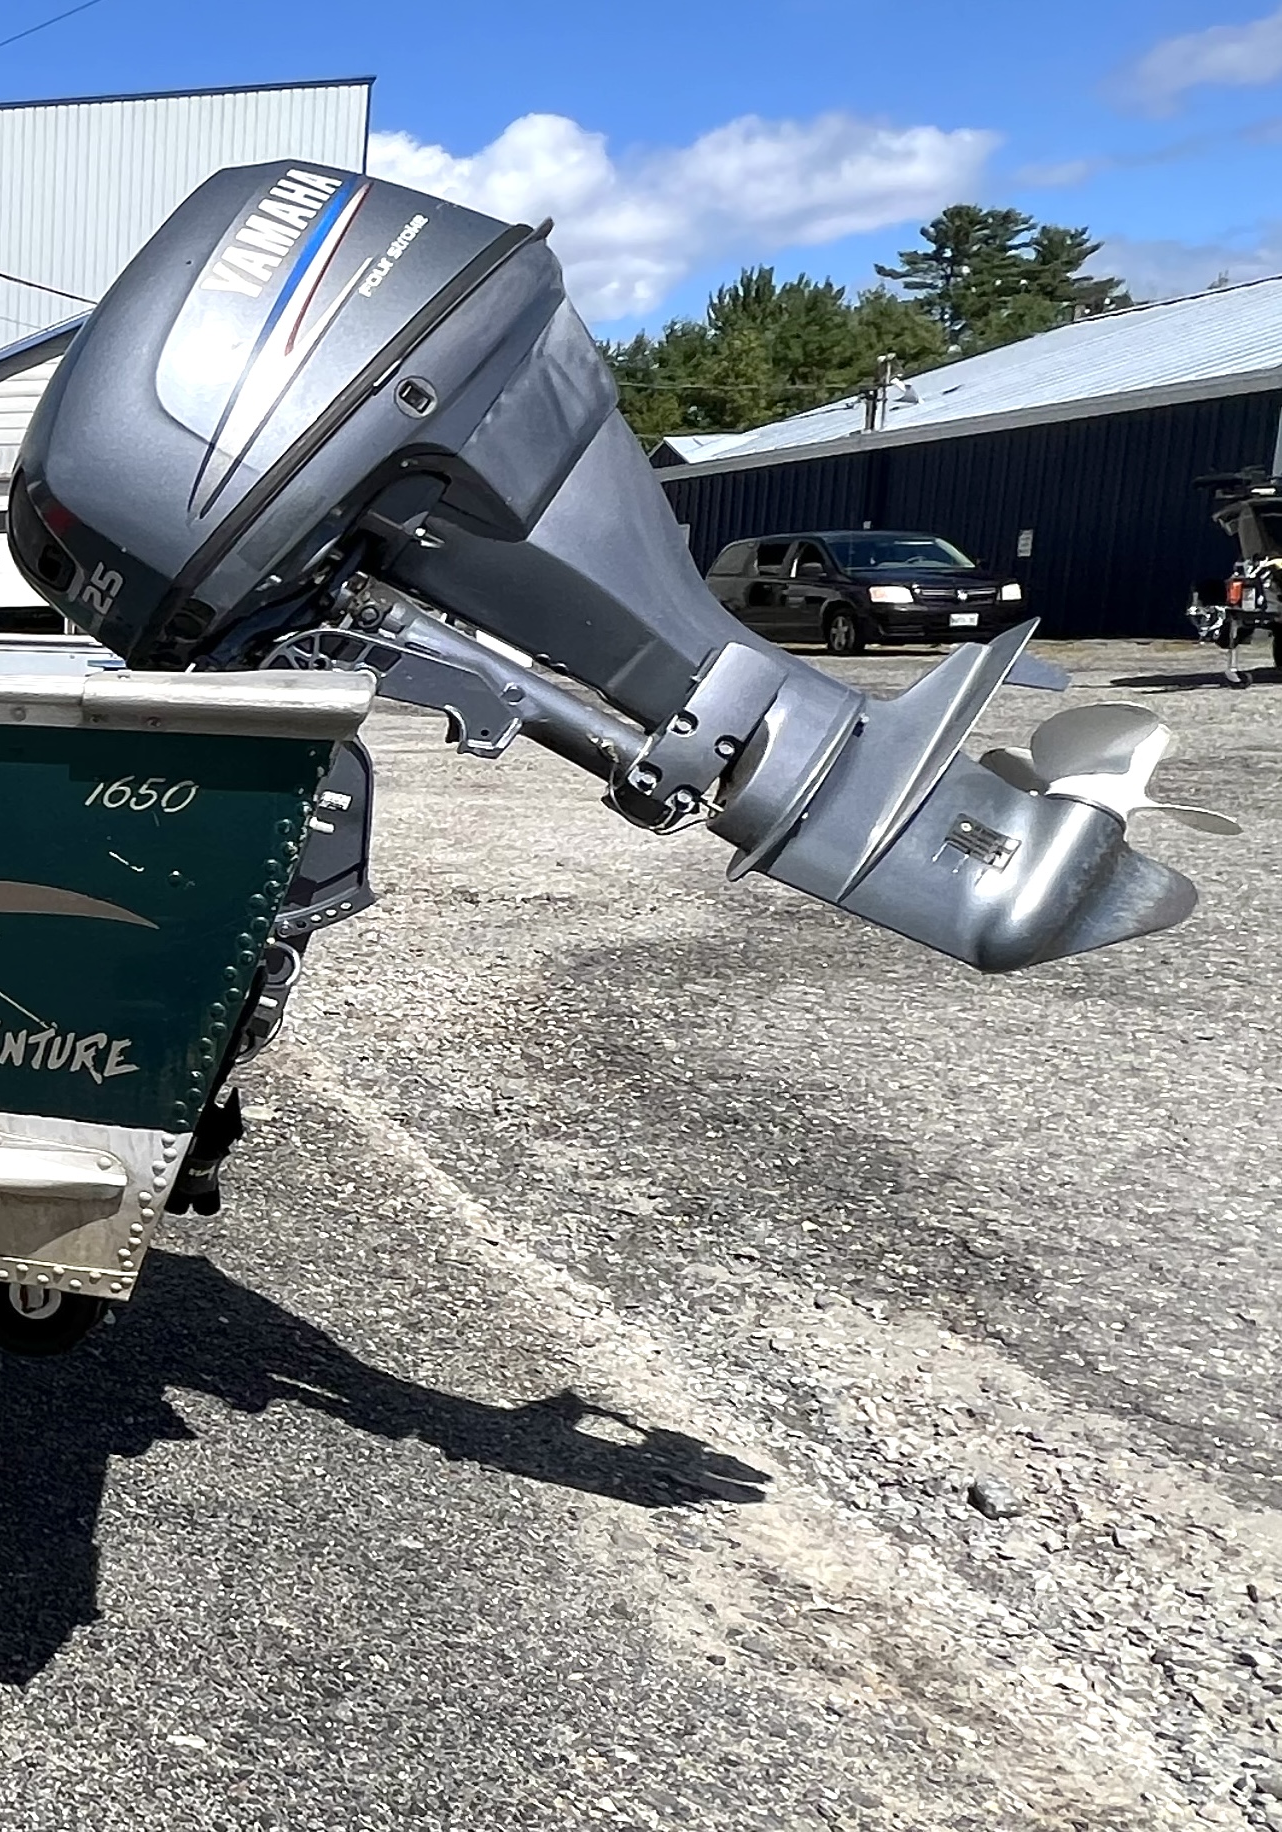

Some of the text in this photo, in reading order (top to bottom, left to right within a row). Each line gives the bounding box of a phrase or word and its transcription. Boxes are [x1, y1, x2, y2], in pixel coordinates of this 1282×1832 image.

[200, 168, 344, 298] YAMAHA
[82, 561, 124, 615] 25
[85, 775, 200, 813] 1650
